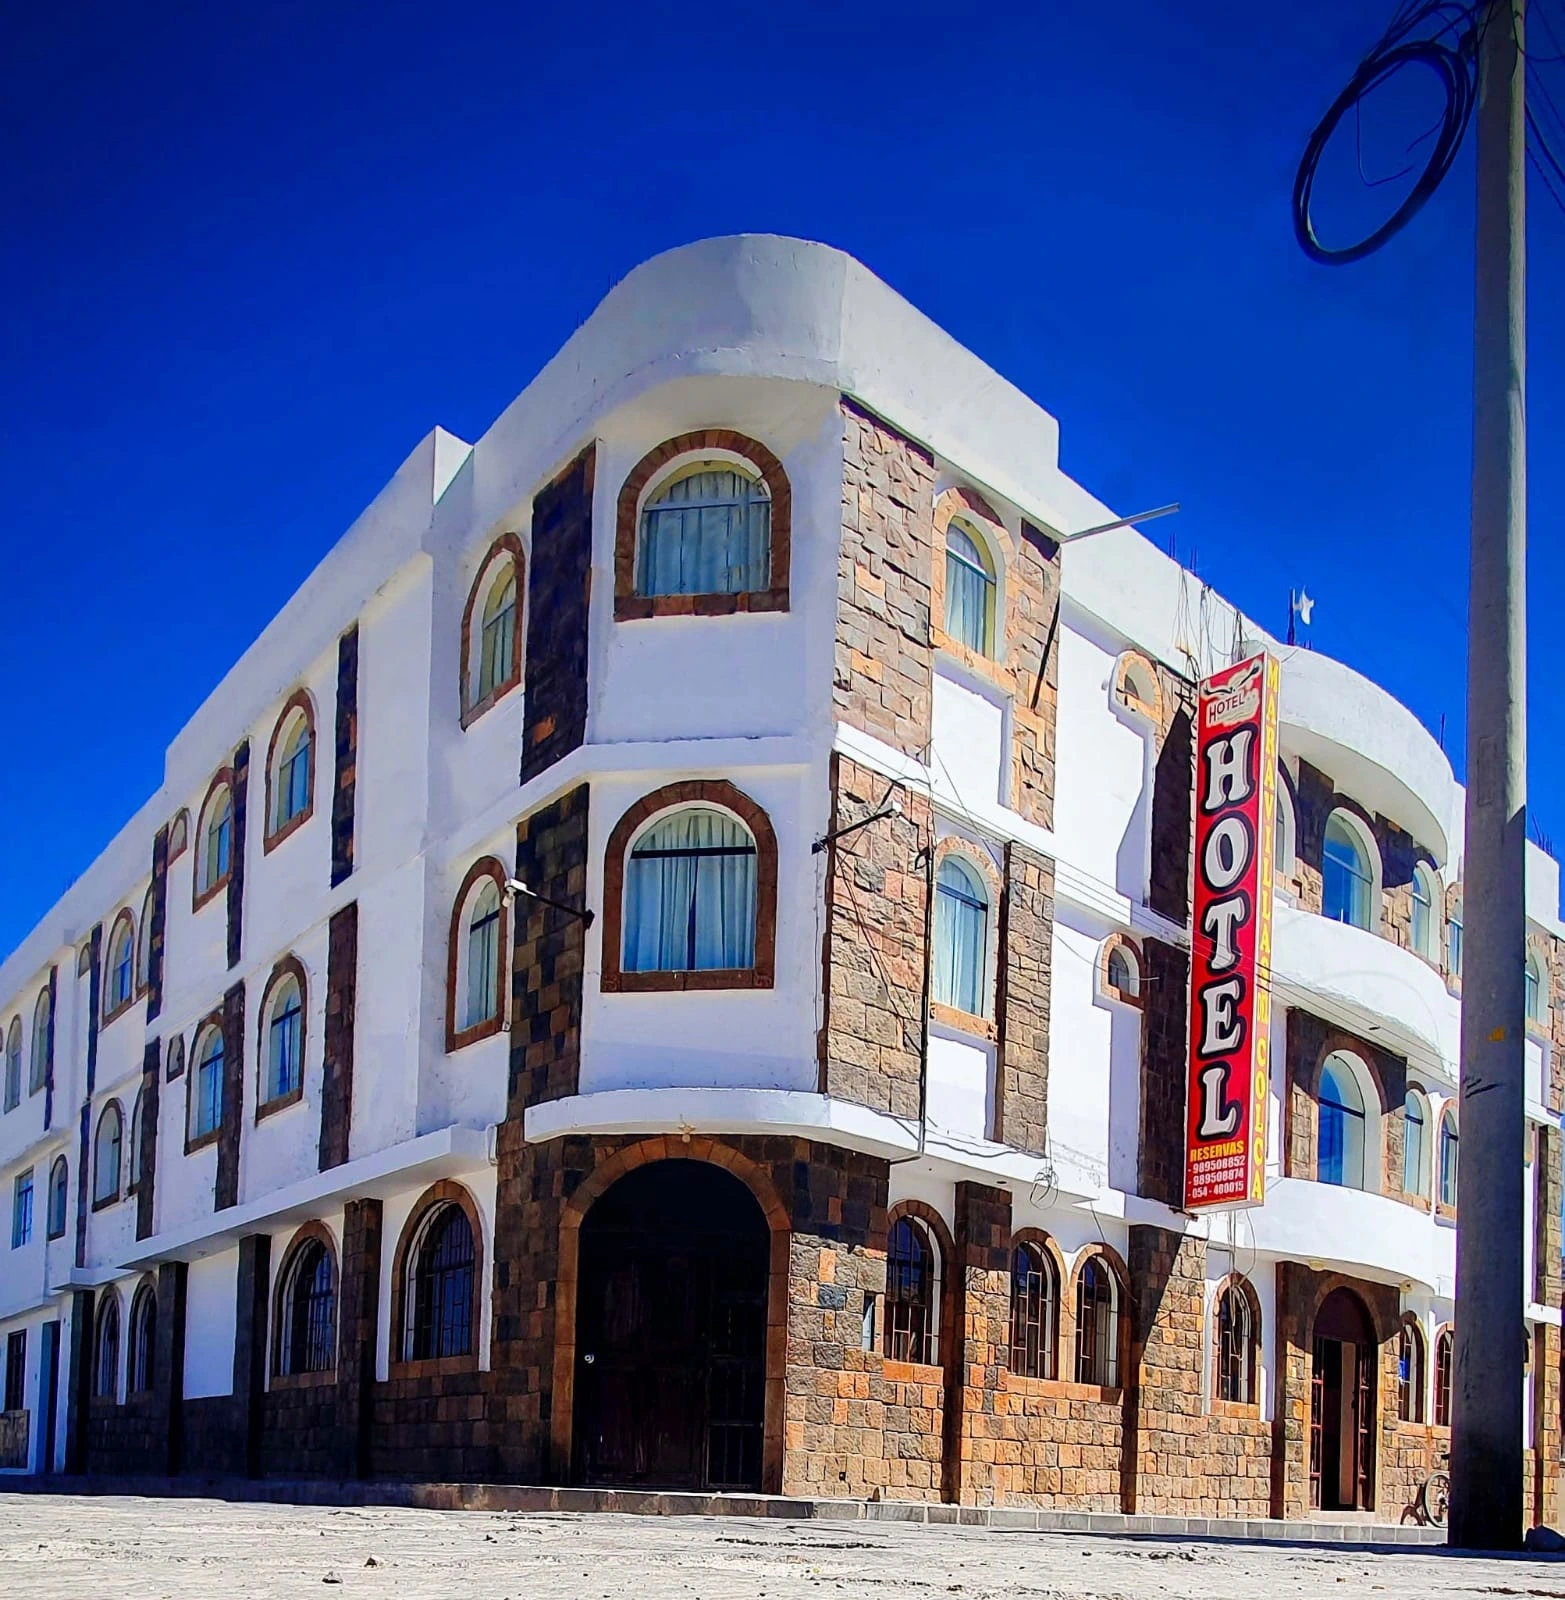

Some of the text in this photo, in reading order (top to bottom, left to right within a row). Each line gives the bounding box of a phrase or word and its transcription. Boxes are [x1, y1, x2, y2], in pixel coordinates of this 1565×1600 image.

[1209, 693, 1244, 724] HOTEL
[1199, 728, 1254, 1138] HOTEL
[1190, 1140, 1245, 1162] RESERVAS
[1252, 1038, 1267, 1200] COLCA
